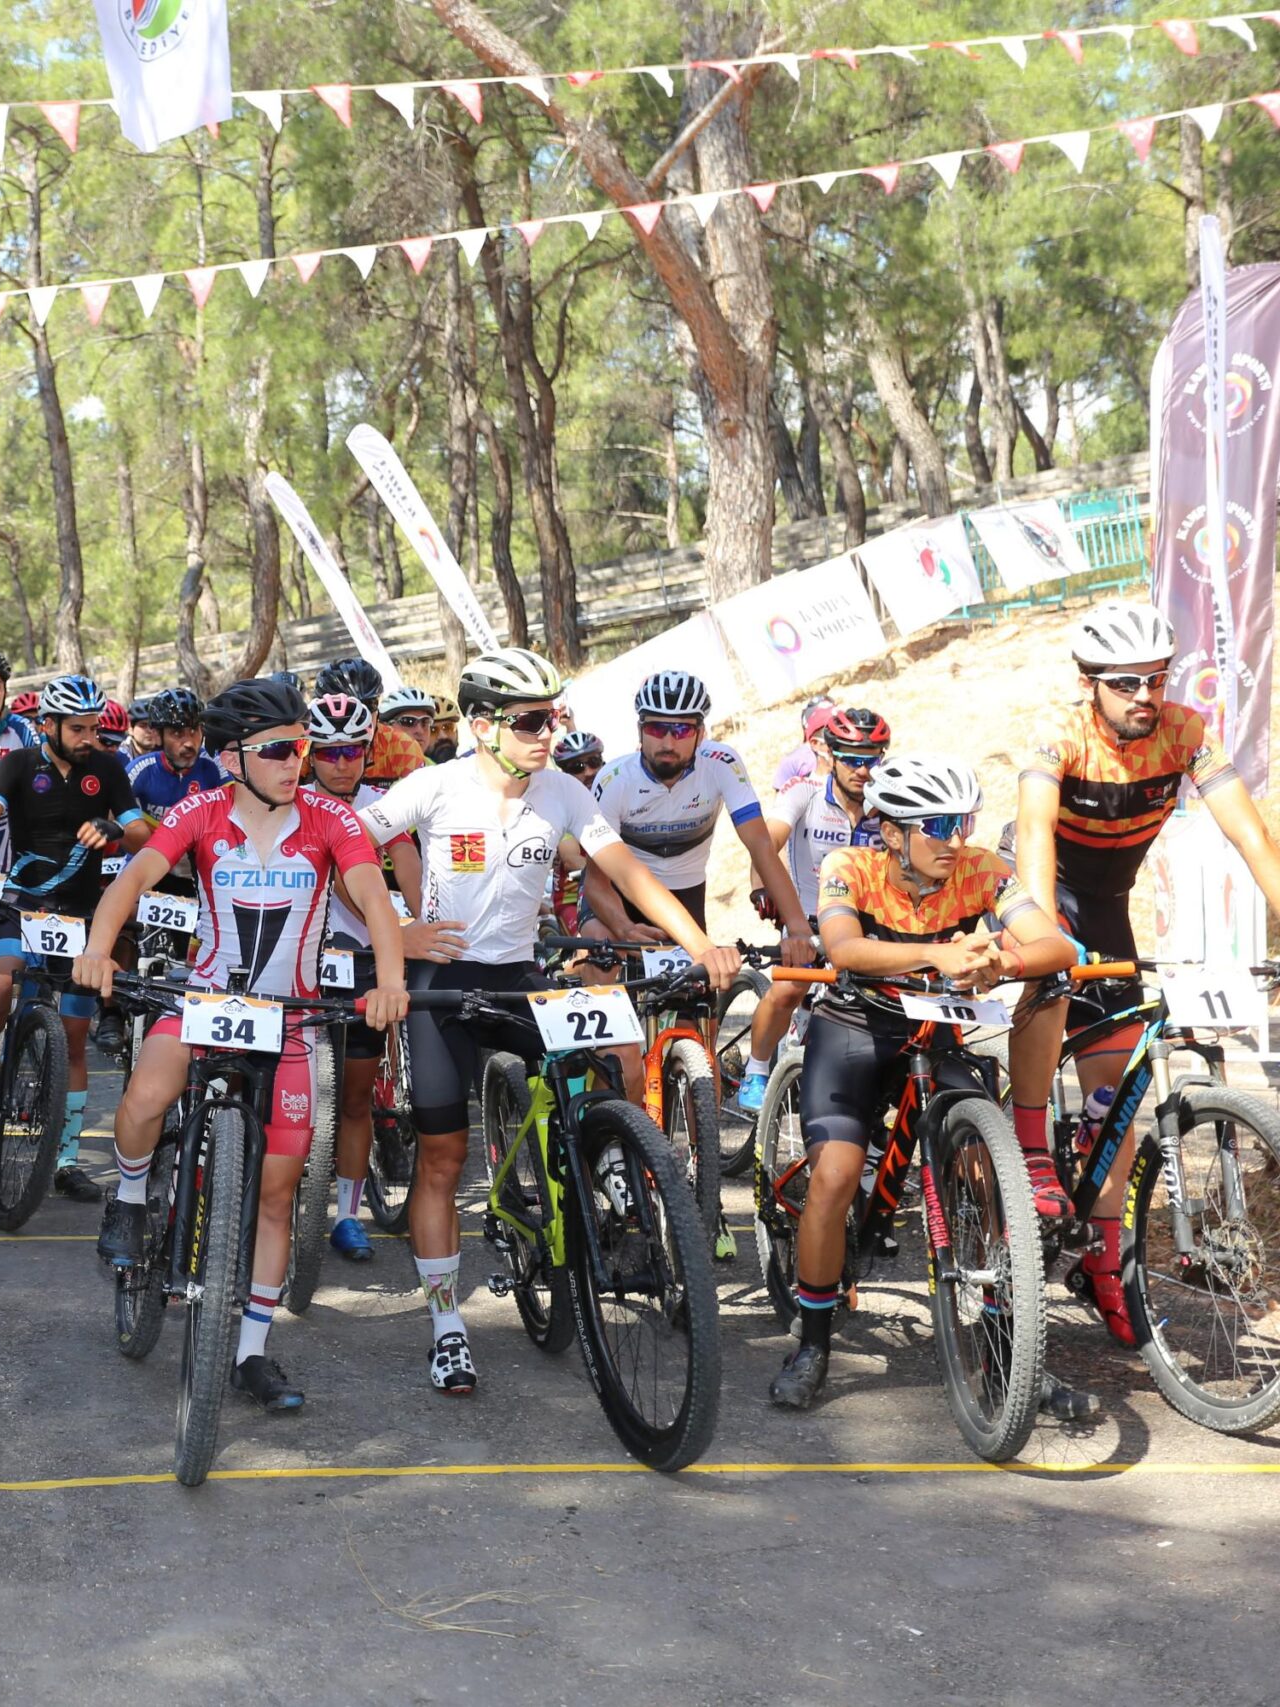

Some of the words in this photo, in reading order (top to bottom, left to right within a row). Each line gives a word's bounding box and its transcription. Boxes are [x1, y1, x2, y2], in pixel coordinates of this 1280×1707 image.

[1231, 352, 1273, 391] SPORTS
[1175, 505, 1207, 541] KAMP
[163, 789, 226, 829] erzurum
[303, 792, 362, 837] erzurum
[813, 829, 846, 842] UHC
[214, 869, 318, 889] erzurum
[148, 905, 186, 928] 325
[41, 931, 69, 952] 52
[1200, 990, 1233, 1019] 11
[211, 1016, 256, 1045] 34
[567, 1010, 613, 1041] 22
[1123, 1156, 1147, 1230] MAXXIS
[923, 1182, 950, 1248] ROCKSHOX
[190, 1193, 206, 1274] MAXXIS
